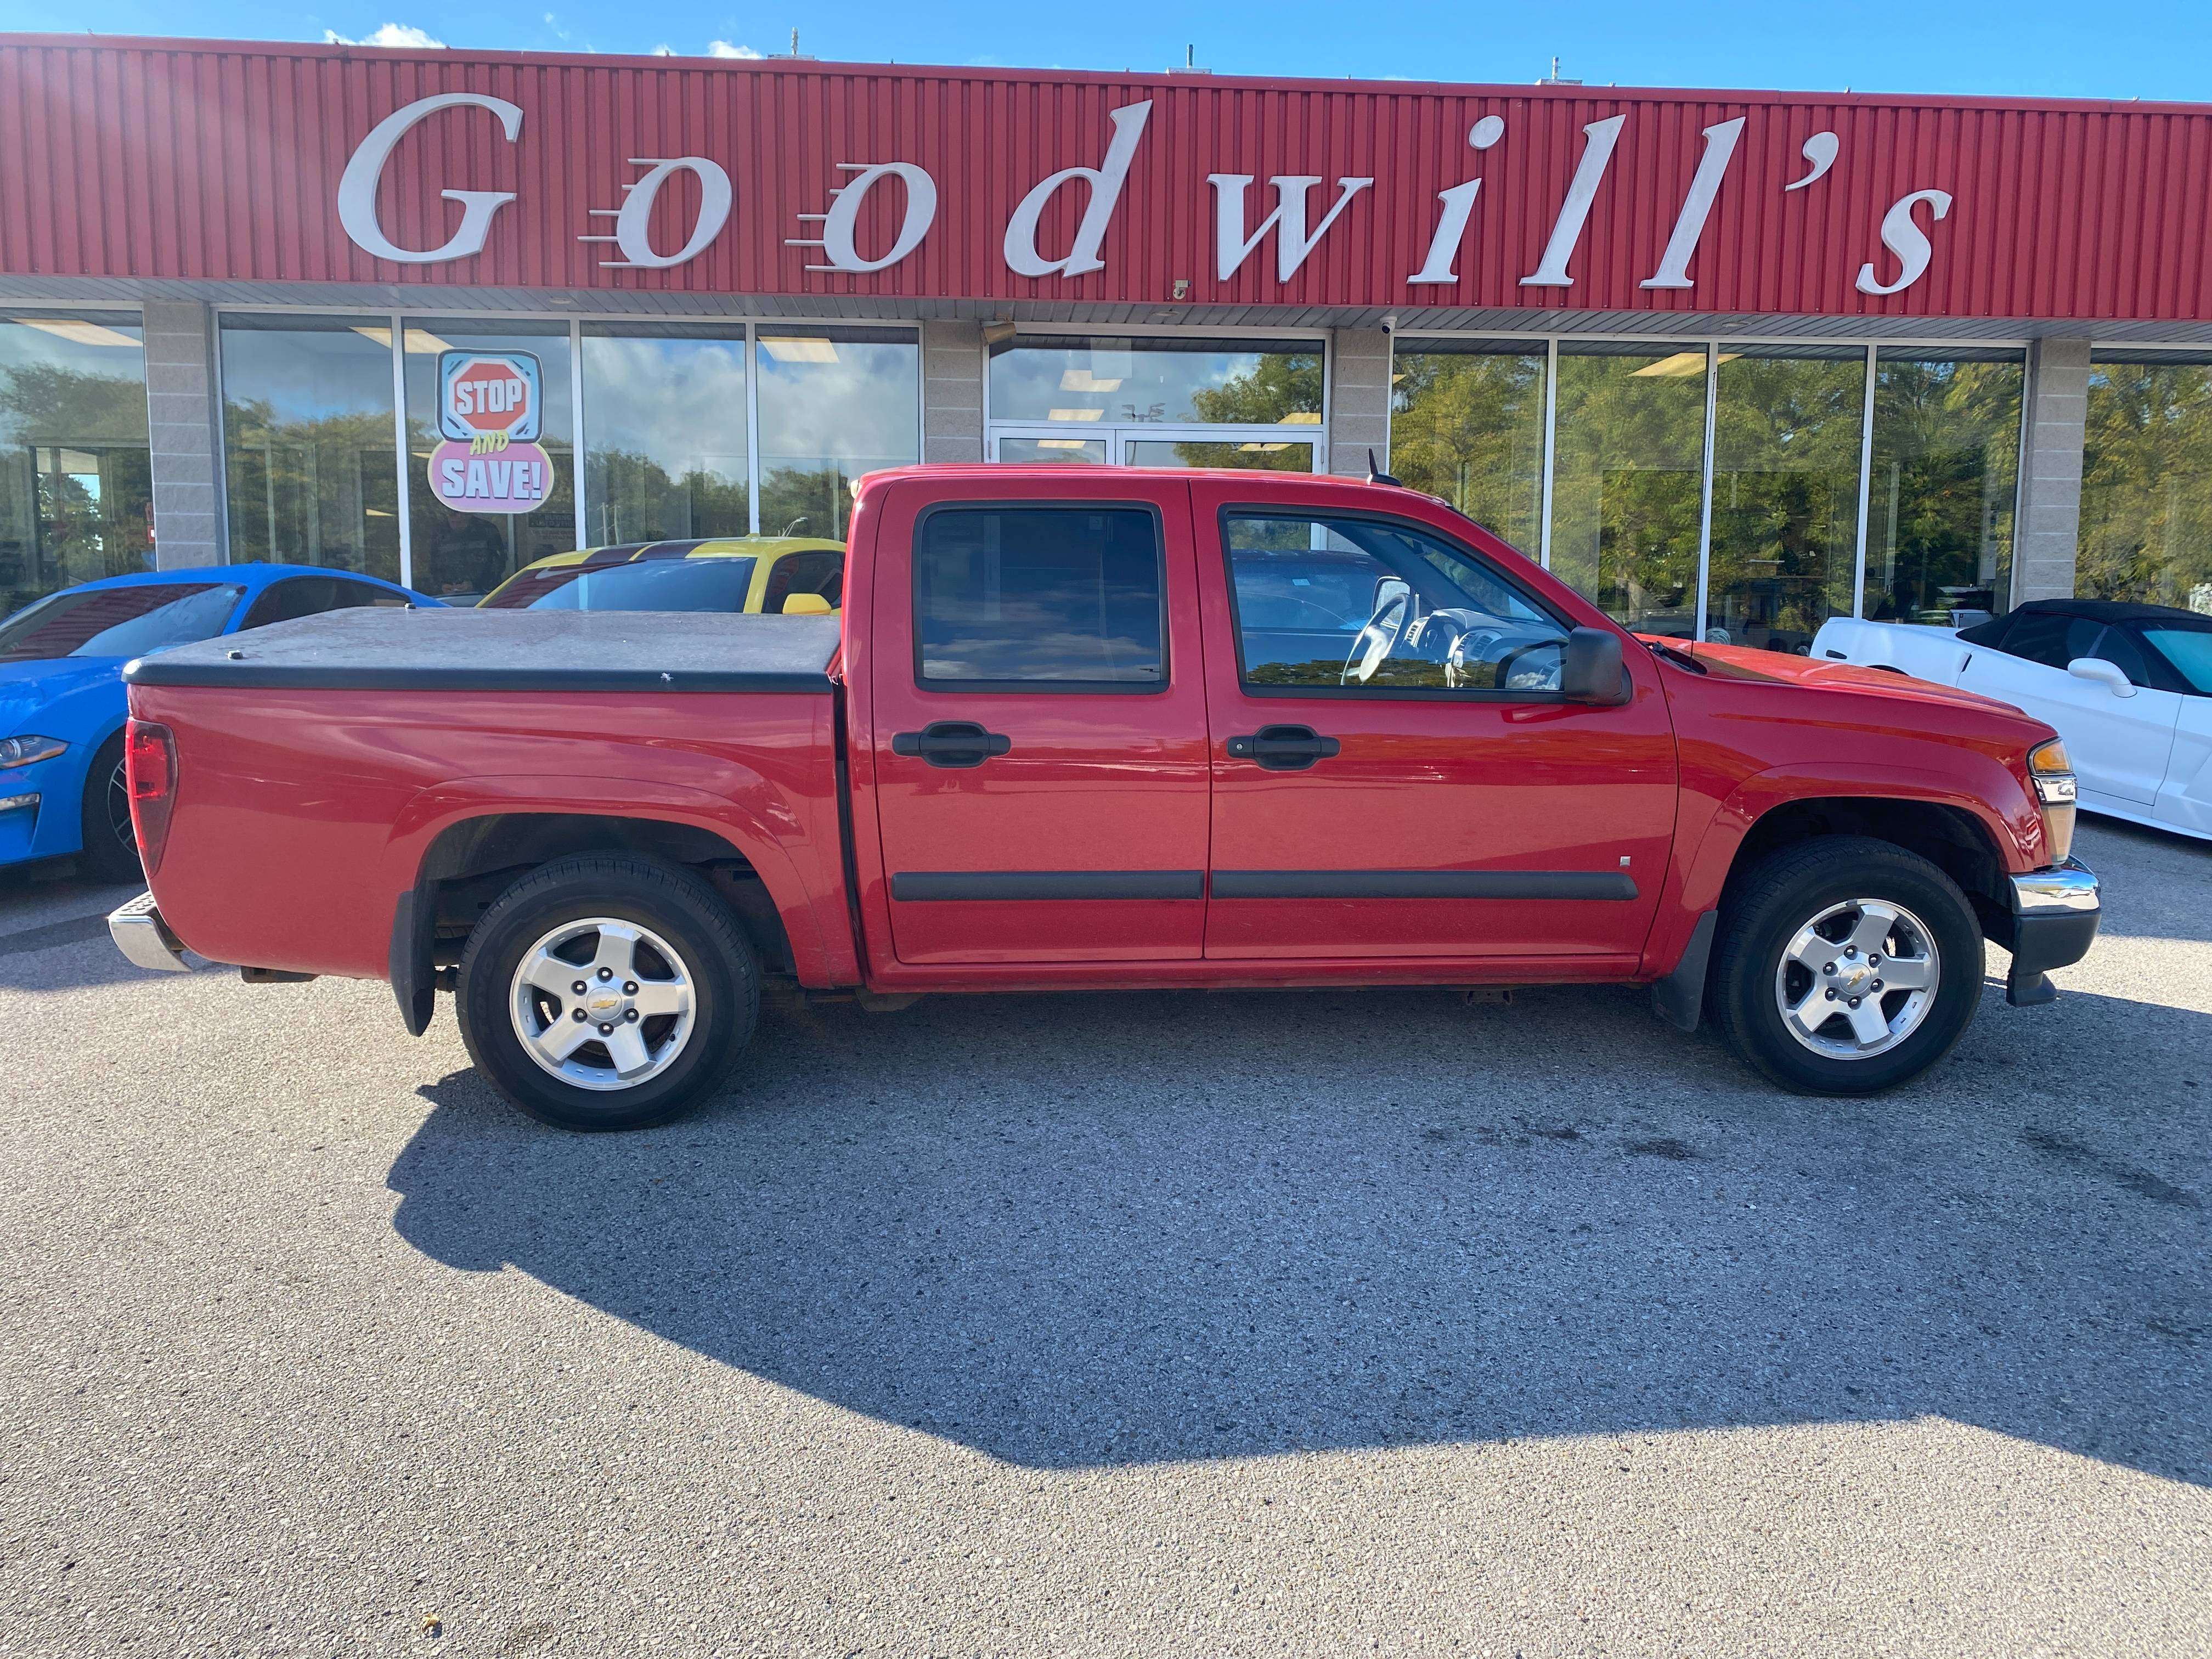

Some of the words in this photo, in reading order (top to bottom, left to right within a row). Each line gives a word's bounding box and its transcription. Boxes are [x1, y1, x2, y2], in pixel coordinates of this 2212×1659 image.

[337, 92, 1953, 296] Goodwill's
[456, 379, 521, 415] STOP
[470, 431, 509, 455] AND
[441, 459, 542, 500] SAVE!
